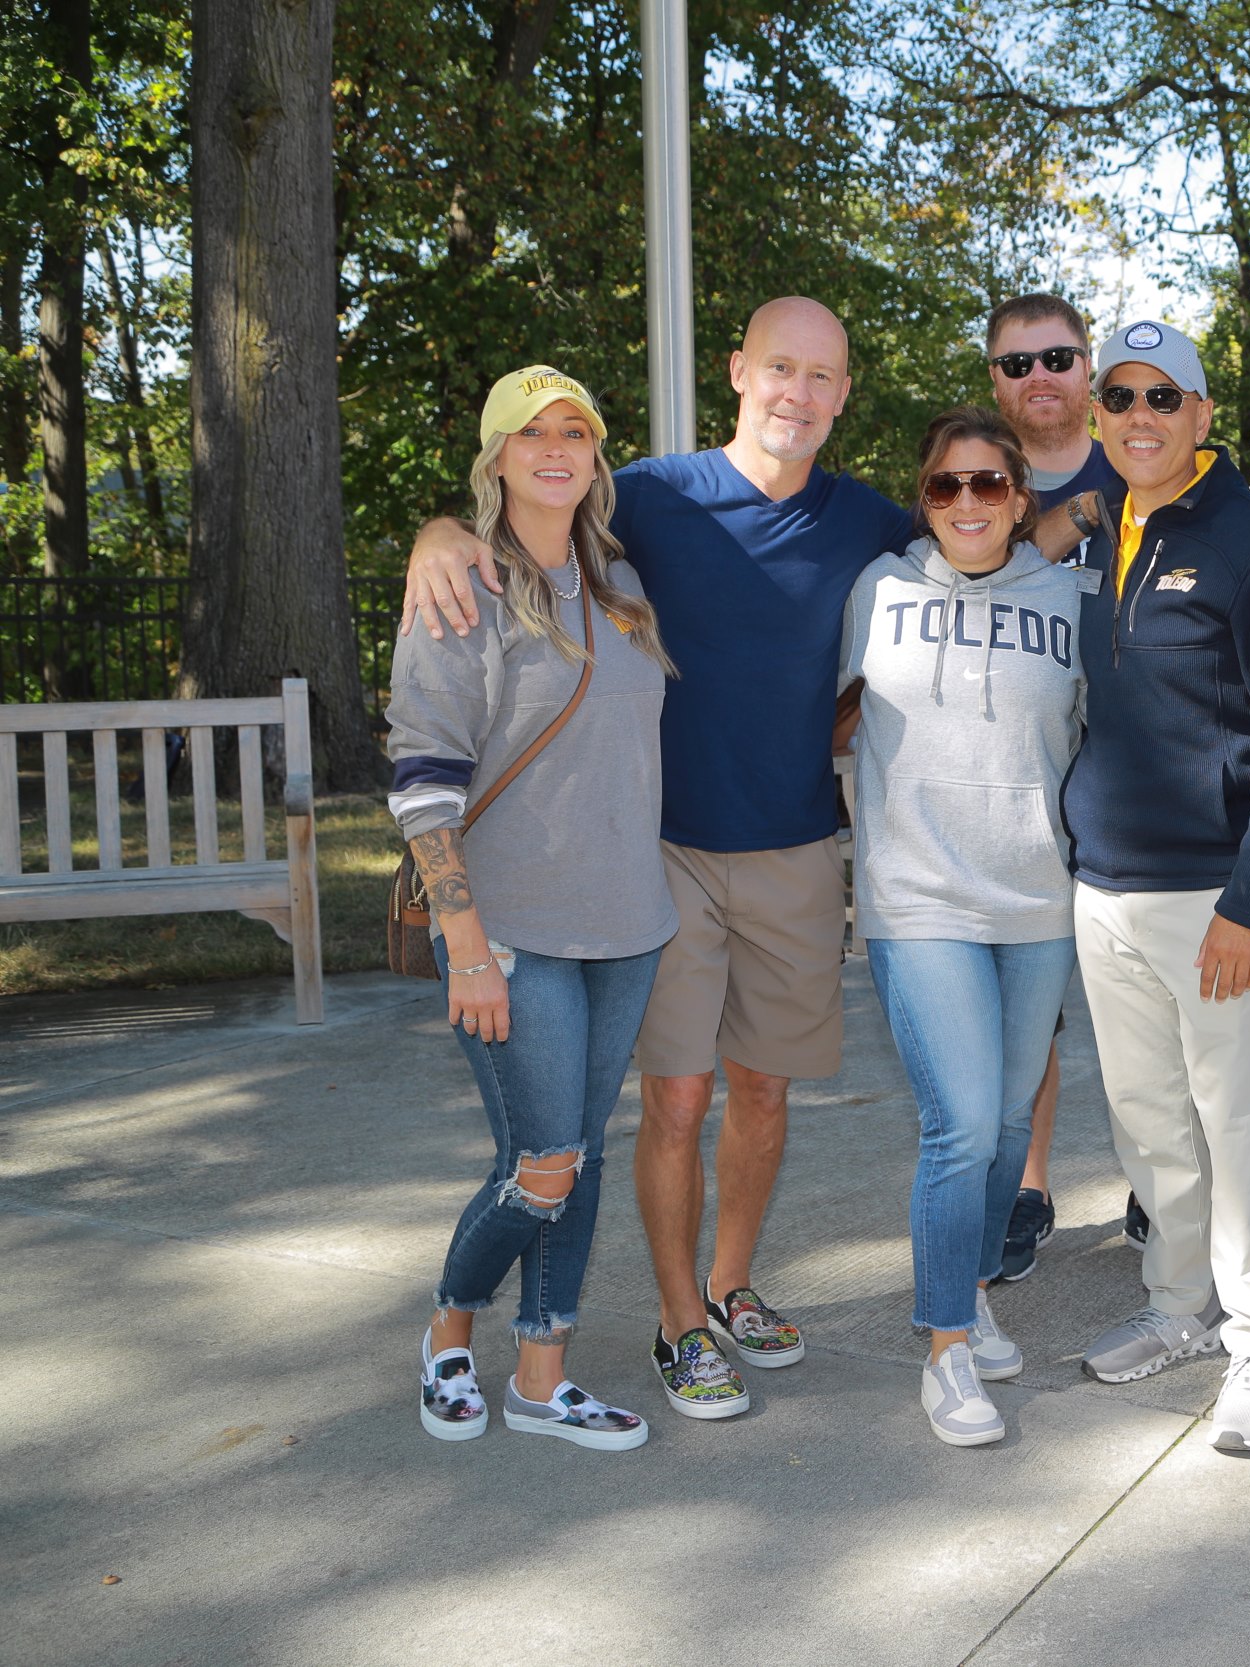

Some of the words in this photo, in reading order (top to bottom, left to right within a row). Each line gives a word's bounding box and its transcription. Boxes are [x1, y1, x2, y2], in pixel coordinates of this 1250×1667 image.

[518, 375, 581, 396] TOLEDO
[1155, 574, 1197, 593] TOLEDO
[886, 597, 1072, 671] TOLEDO
